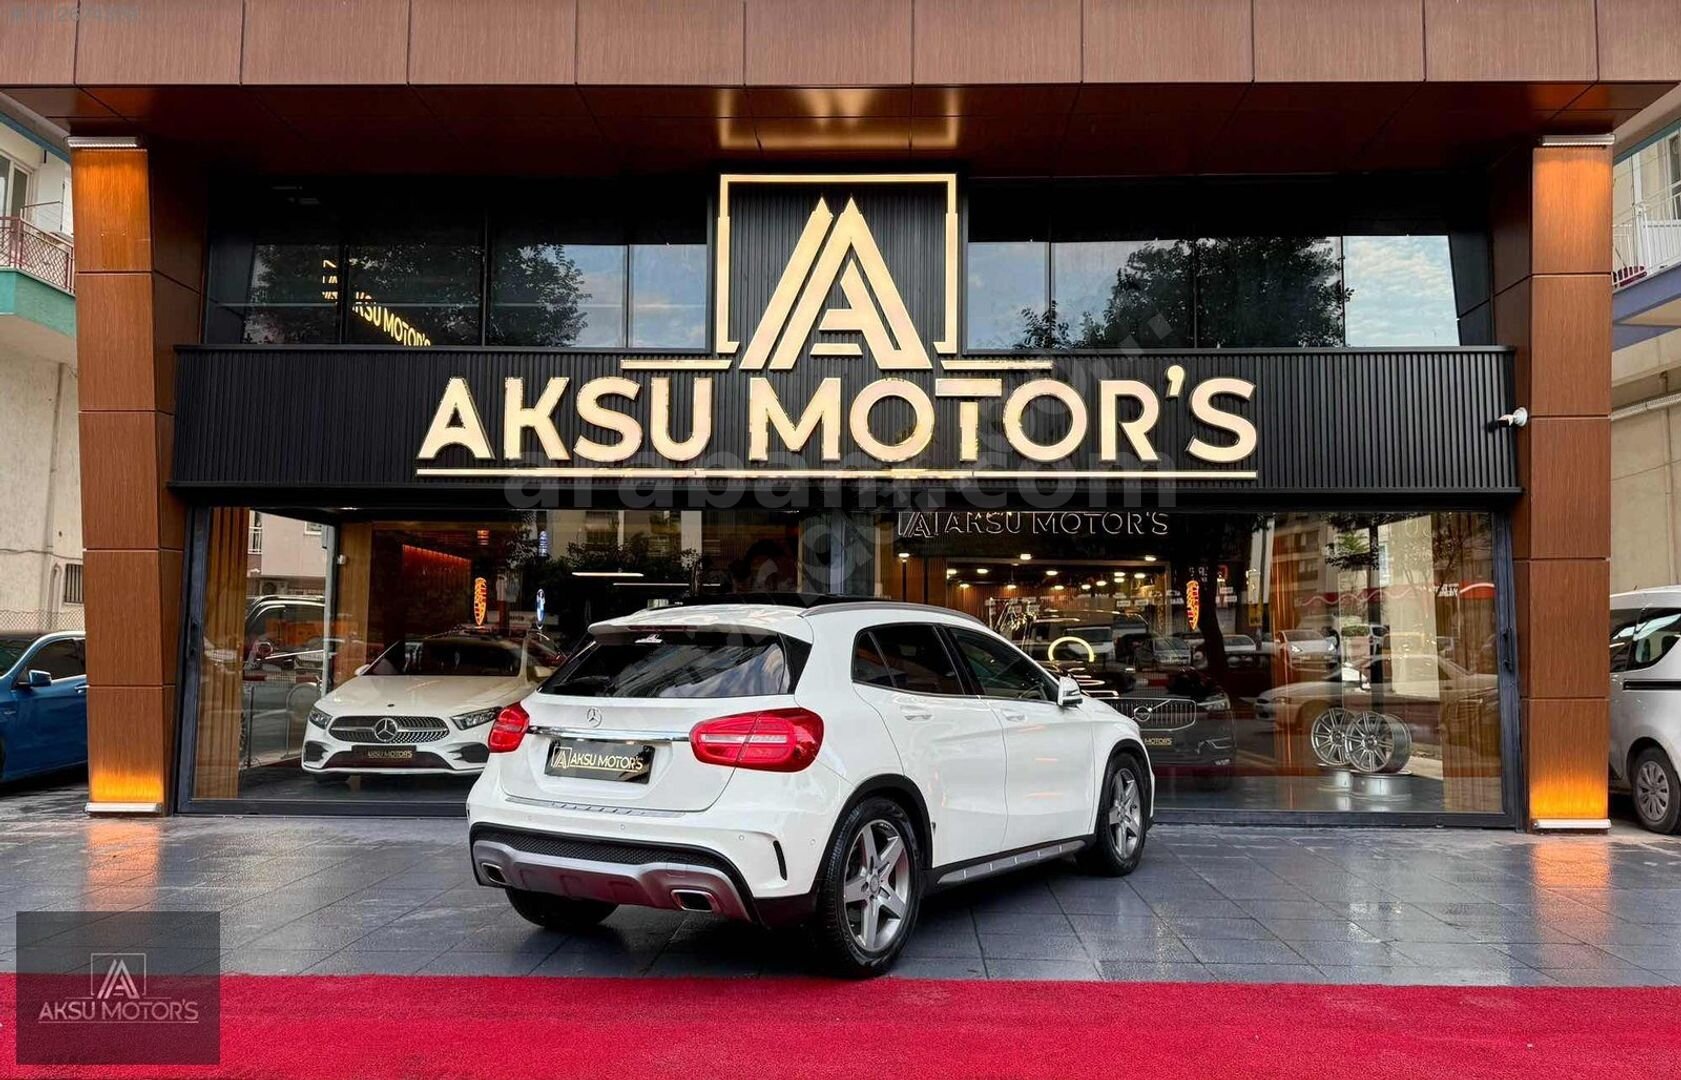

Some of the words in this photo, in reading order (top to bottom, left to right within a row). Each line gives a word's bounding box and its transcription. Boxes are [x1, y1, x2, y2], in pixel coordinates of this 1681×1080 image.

[416, 376, 713, 463] AKSU
[748, 364, 1258, 463] MOTOR'S
[944, 511, 1021, 534] AKSU
[1032, 511, 1169, 535] MOTOR'S
[570, 753, 598, 766] AKSU
[598, 754, 644, 770] MOTOR'S
